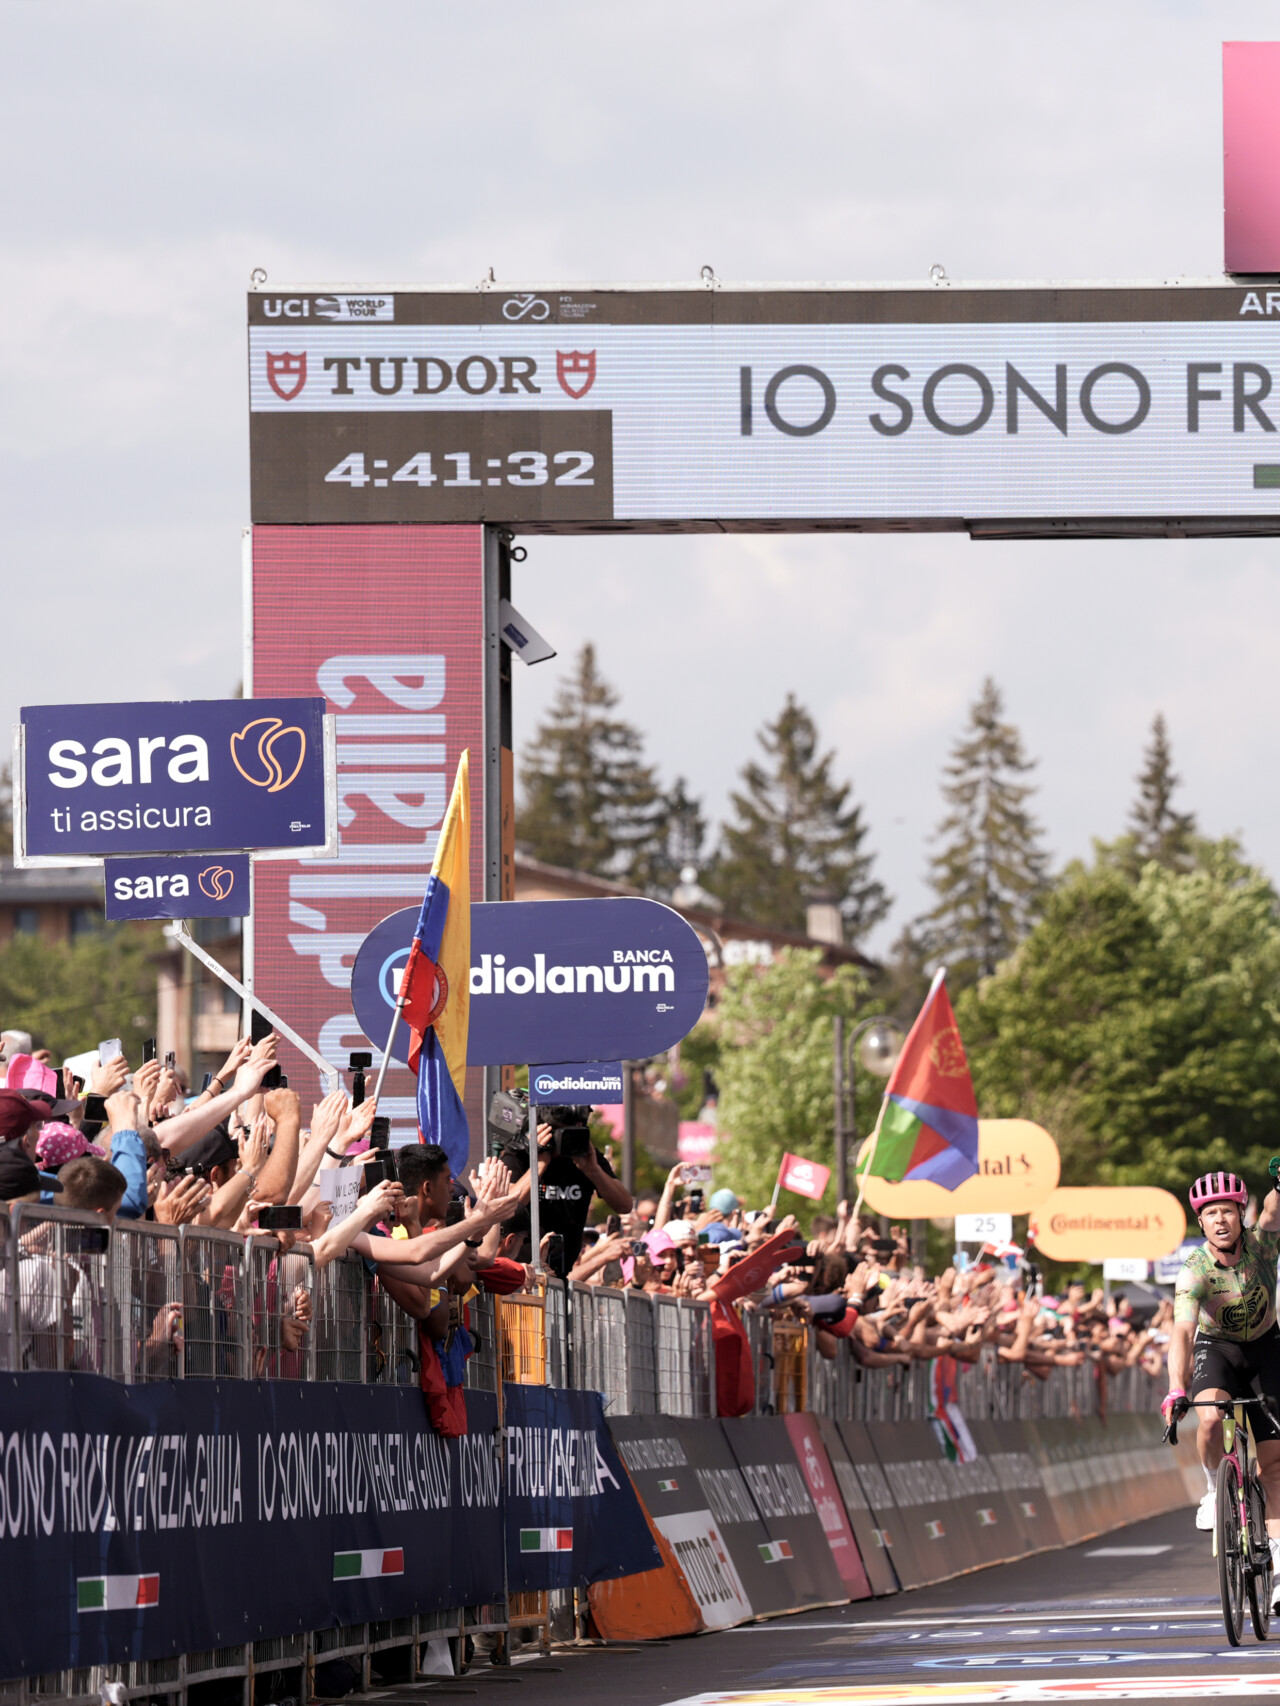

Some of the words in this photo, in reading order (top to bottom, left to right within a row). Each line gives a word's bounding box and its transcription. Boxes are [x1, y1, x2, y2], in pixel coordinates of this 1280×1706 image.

[263, 299, 310, 318] UCI
[346, 299, 386, 308] WORLD
[350, 308, 377, 317] TOUR
[323, 355, 542, 396] TUDOR
[740, 363, 837, 438] IO
[868, 361, 1152, 438] SONO
[324, 449, 596, 488] 4:41:32
[47, 733, 210, 789] sara
[50, 806, 71, 833] ti
[80, 802, 212, 832] assicura
[113, 873, 190, 901] sara
[613, 949, 673, 964] BANCA
[538, 1075, 621, 1091] mediolanum
[545, 1184, 582, 1201] EMG
[975, 1217, 997, 1233] 25
[1050, 1212, 1150, 1236] Continental
[507, 1425, 549, 1499] FRIULI
[193, 1430, 243, 1528] GIULIA
[257, 1431, 277, 1523] IO
[278, 1429, 323, 1521] SONO
[459, 1433, 473, 1508] IO
[907, 1630, 985, 1640] IO
[1006, 1623, 1224, 1636] SONO
